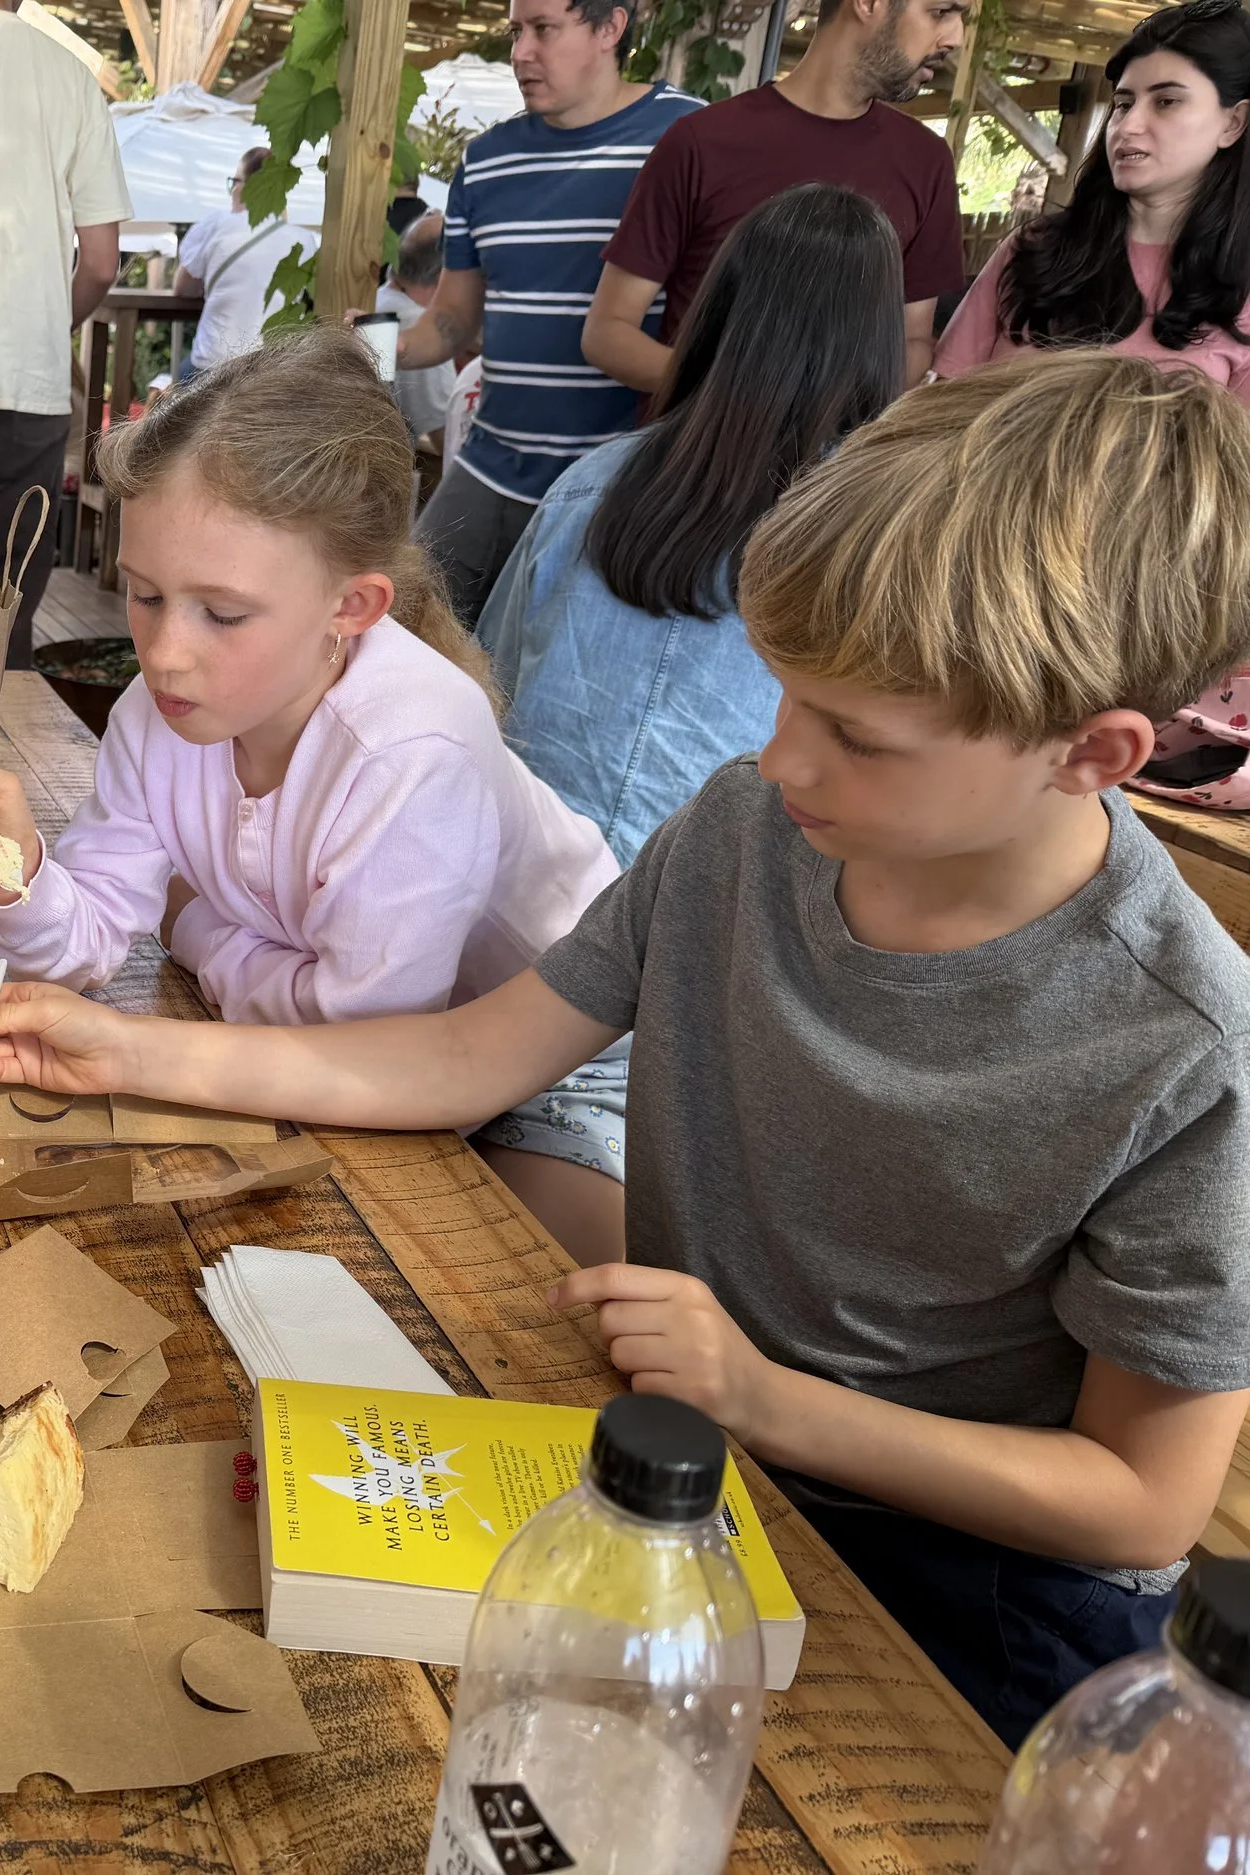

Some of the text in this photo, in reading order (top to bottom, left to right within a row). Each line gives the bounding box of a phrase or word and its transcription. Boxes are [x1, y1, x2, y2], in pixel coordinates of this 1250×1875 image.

[276, 1393, 300, 1540] THE NUMBER ONE BESTSELLER
[343, 1416, 372, 1525] WINNING WILL
[364, 1404, 402, 1550] MAKE YOU FAMOUS.
[390, 1421, 424, 1532] LOSING MEANS
[414, 1419, 450, 1541] CERTAIN DEATH.
